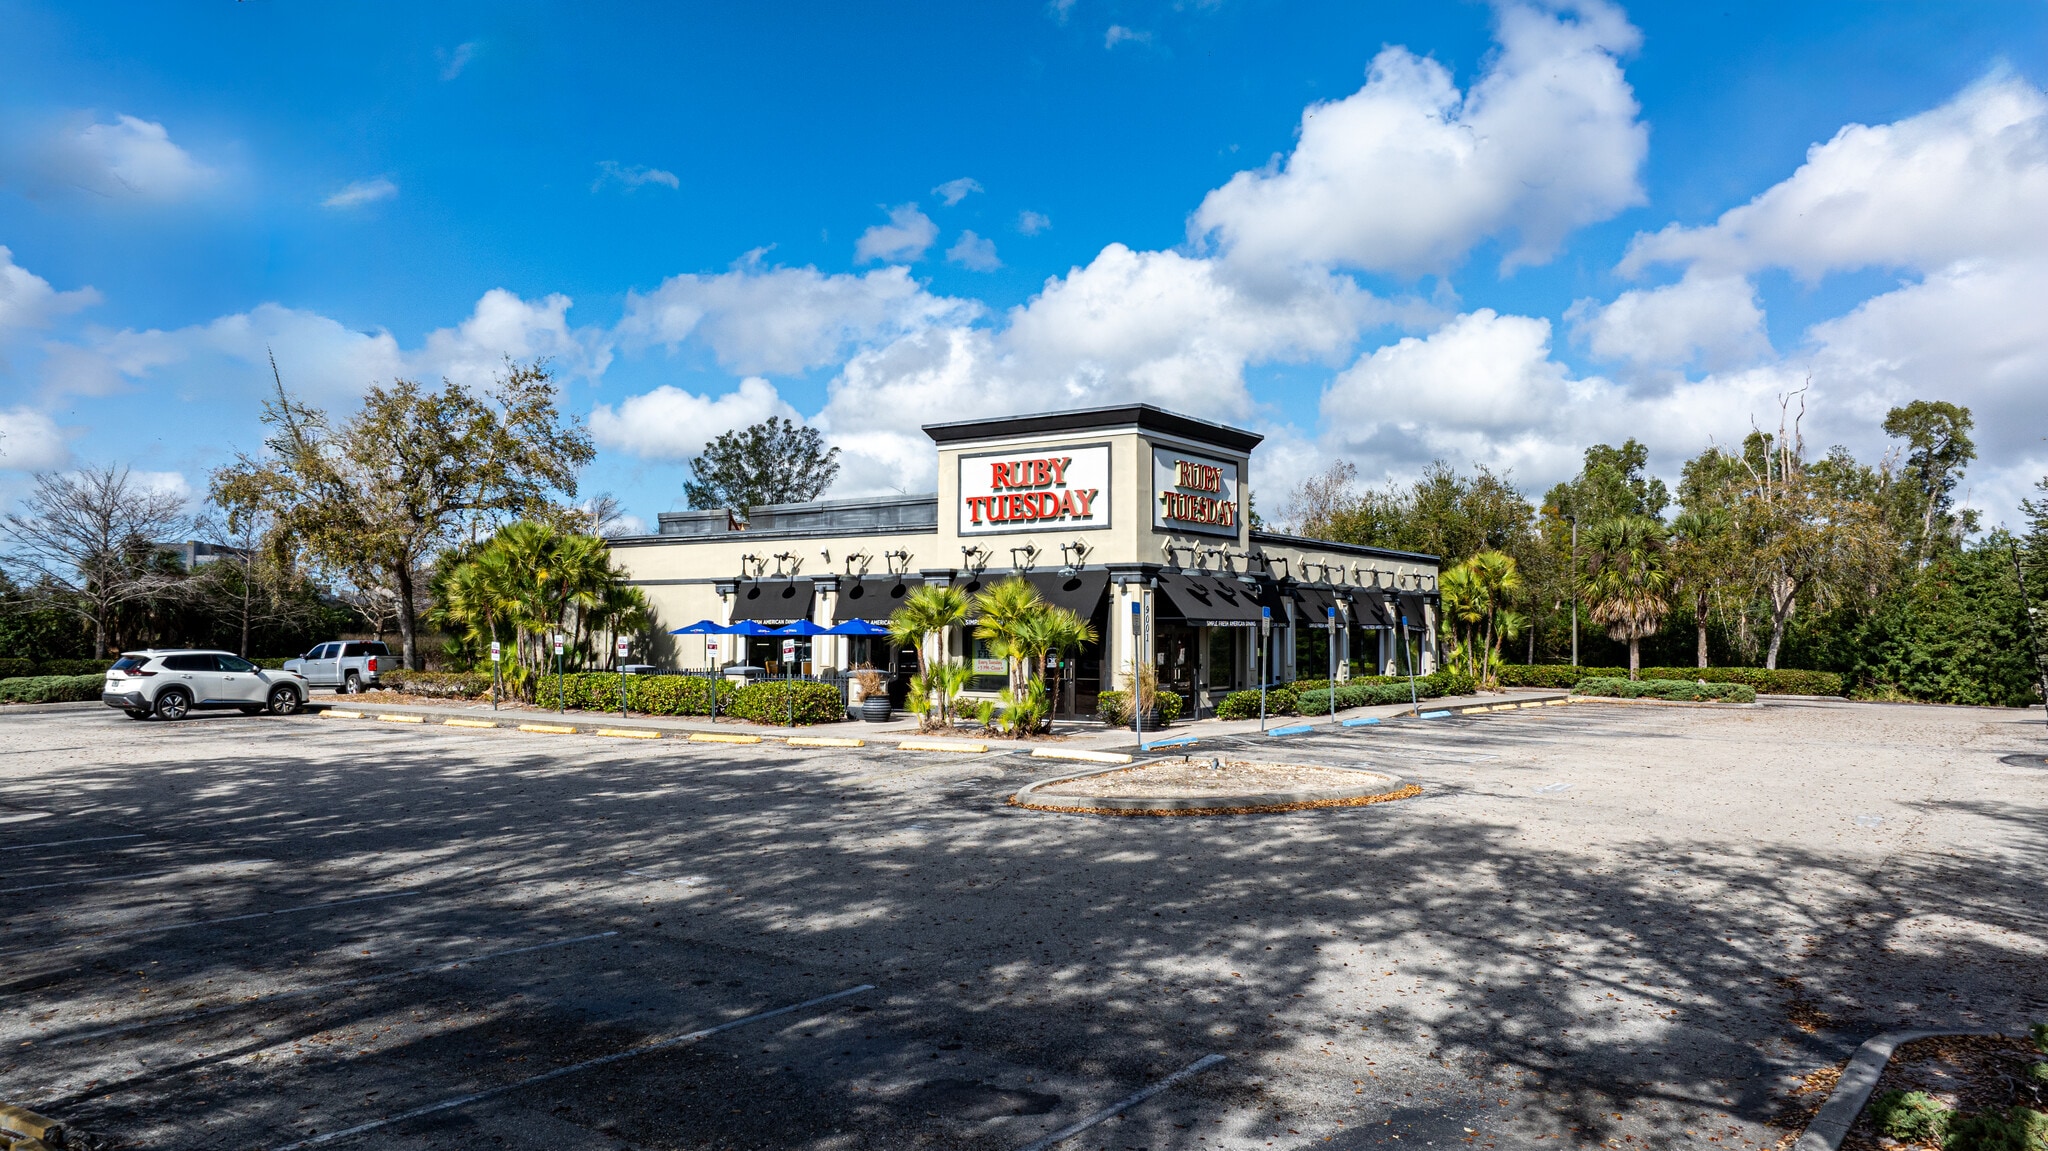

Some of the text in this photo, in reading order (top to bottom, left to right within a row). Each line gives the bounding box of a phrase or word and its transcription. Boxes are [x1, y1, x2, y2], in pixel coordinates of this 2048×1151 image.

[990, 457, 1071, 491] RUBY
[1176, 460, 1223, 492] RUBY
[966, 489, 1098, 525] TUESDAY
[1161, 491, 1236, 526] TUESDAY
